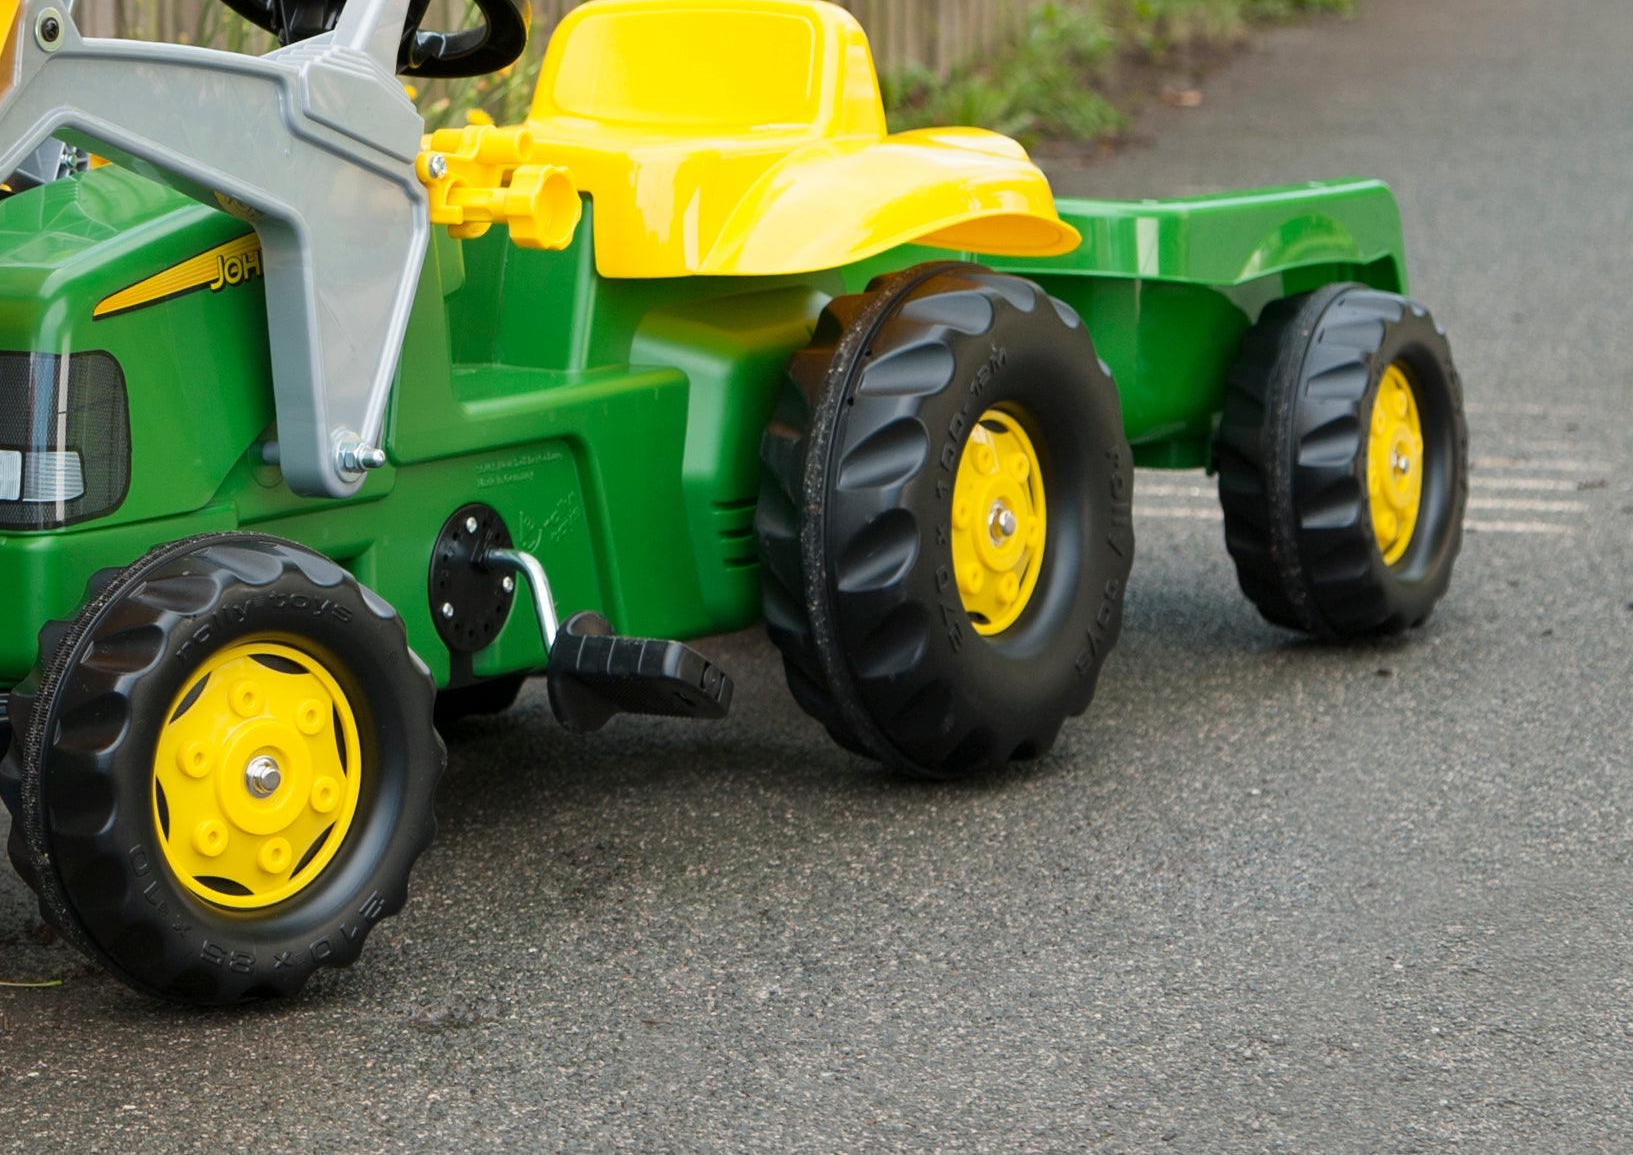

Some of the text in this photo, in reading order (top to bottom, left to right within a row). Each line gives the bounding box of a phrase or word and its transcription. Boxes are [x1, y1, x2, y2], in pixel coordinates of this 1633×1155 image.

[211, 251, 261, 290] JOH
[176, 590, 353, 662] rolly toys
